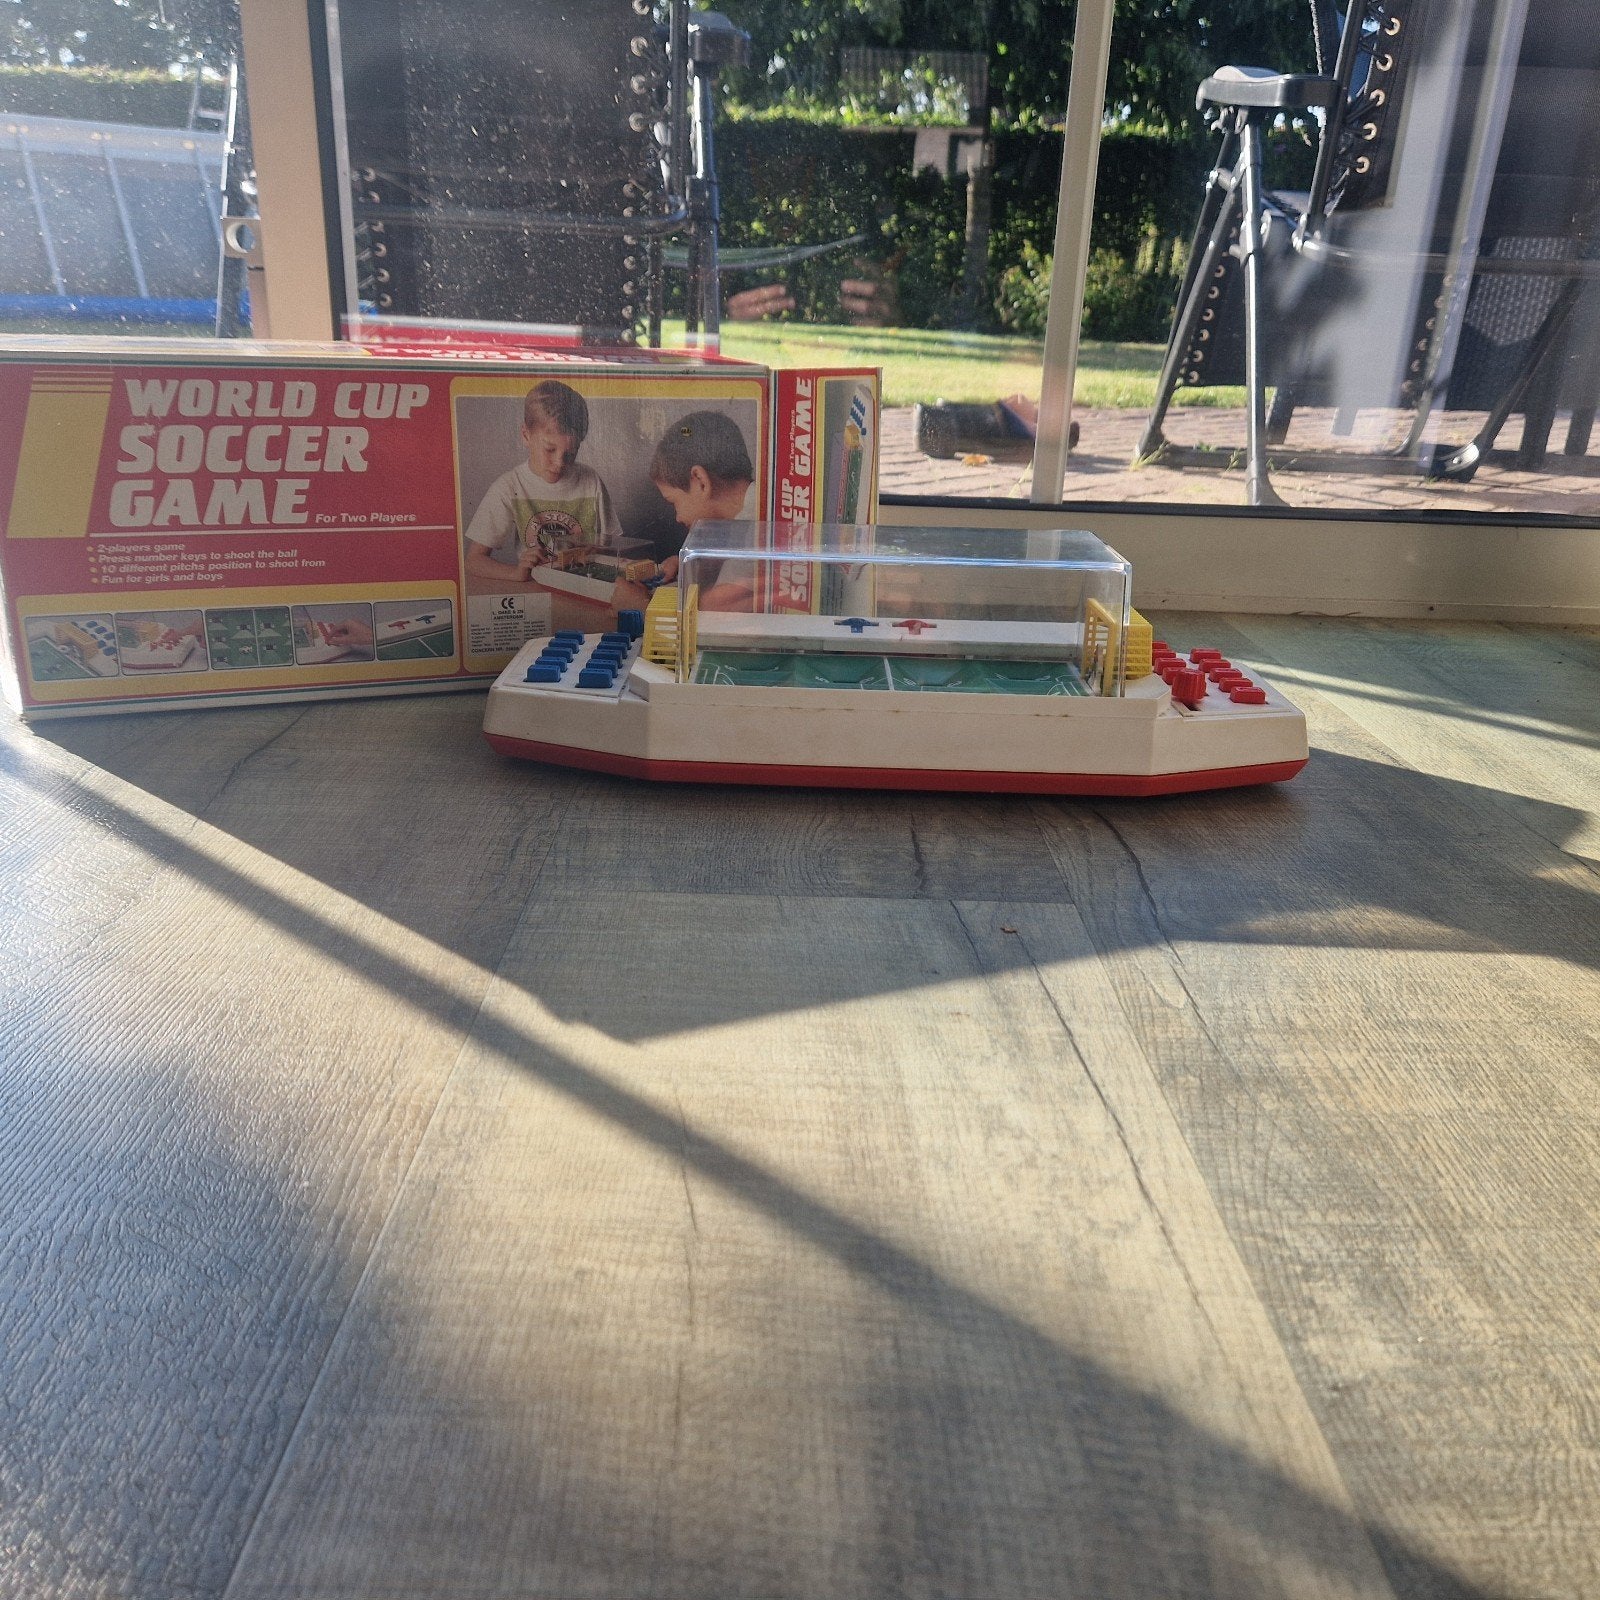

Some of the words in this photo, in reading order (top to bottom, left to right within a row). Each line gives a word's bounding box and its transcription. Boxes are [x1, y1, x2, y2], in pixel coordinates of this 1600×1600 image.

[124, 378, 316, 418] WORLD
[333, 382, 430, 419] CUP
[794, 376, 812, 477] GAME
[116, 423, 370, 474] SOCCER
[108, 478, 311, 527] GAME
[781, 478, 794, 519] CUP
[315, 513, 337, 523] For
[340, 512, 367, 522] Two
[370, 512, 417, 523] Players
[97, 543, 151, 553] 2-players
[153, 543, 186, 552] game
[98, 555, 132, 563] Press
[134, 553, 178, 562] number
[180, 552, 207, 561] keys
[210, 551, 222, 560] to
[224, 551, 255, 559] shoot
[257, 550, 275, 559] the
[277, 549, 298, 558] ball
[101, 565, 116, 573] 10
[119, 563, 168, 572] different
[170, 562, 205, 572] pitchs
[208, 560, 252, 571] position
[255, 561, 267, 569] to
[269, 560, 299, 568] shoot
[301, 559, 326, 567] from
[101, 575, 123, 583] Fun
[126, 574, 142, 582] for
[145, 574, 170, 584] girls
[173, 573, 194, 581] and
[197, 572, 223, 582] boys
